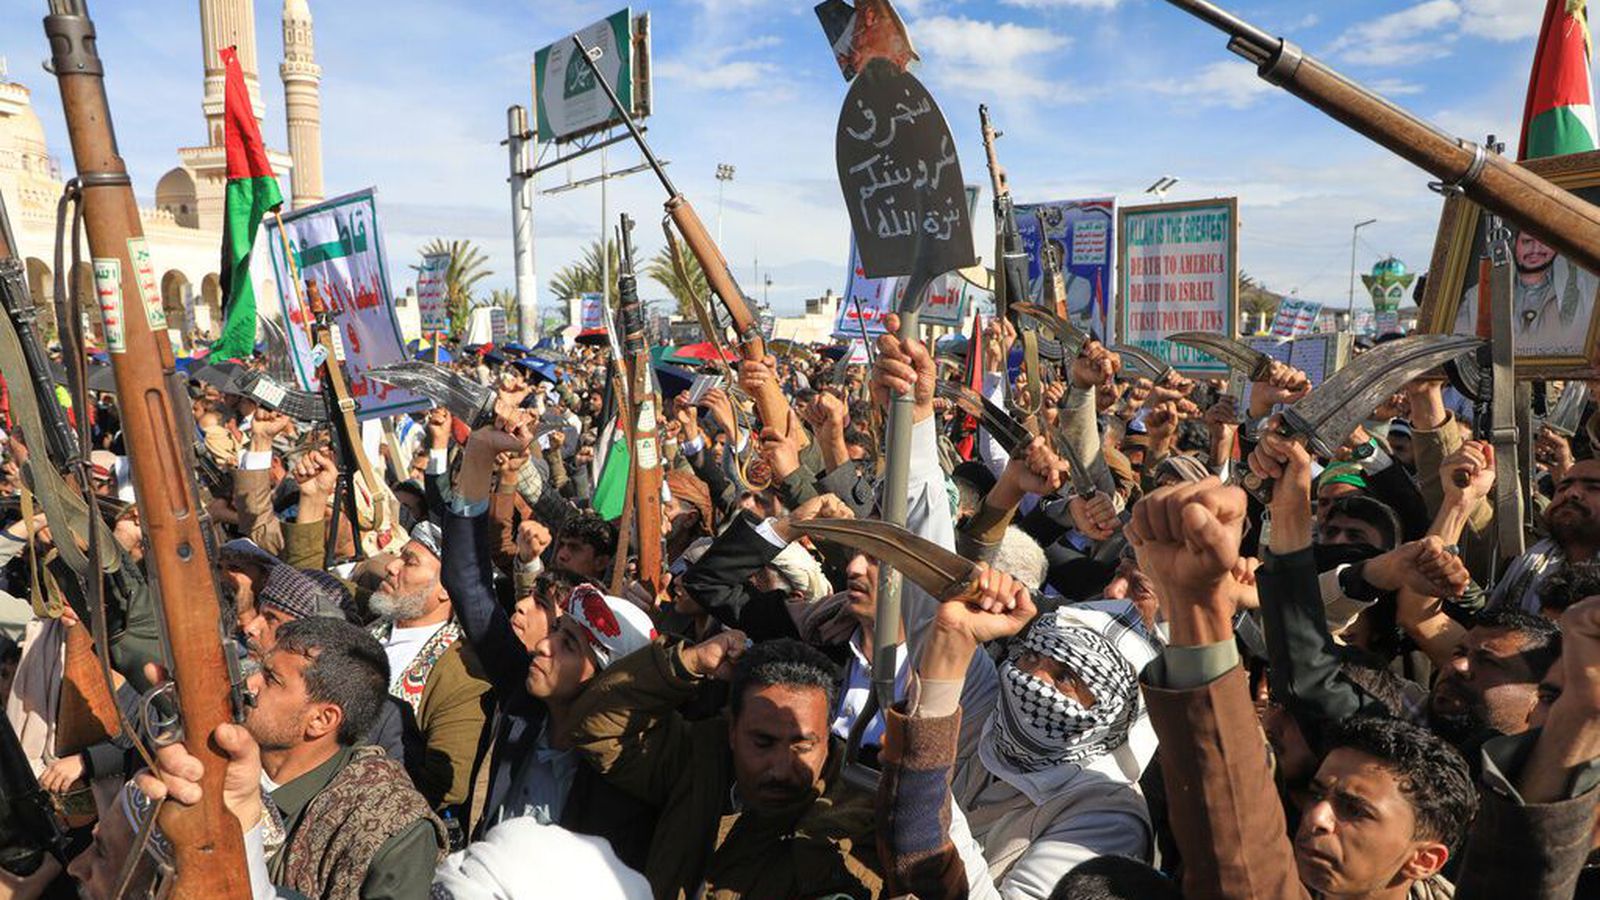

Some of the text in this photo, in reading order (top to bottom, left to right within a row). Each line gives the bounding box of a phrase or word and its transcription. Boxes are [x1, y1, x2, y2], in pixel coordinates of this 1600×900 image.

[877, 196, 918, 240] الله
[1130, 218, 1155, 246] ALLAH
[1165, 216, 1182, 243] THE
[1185, 212, 1227, 241] GREATEST
[1130, 253, 1224, 276] DEATH TO AMERICA
[1130, 281, 1214, 302] DEATH TO ISRAEL
[1129, 310, 1224, 332] CURSE UPON THE JEWS
